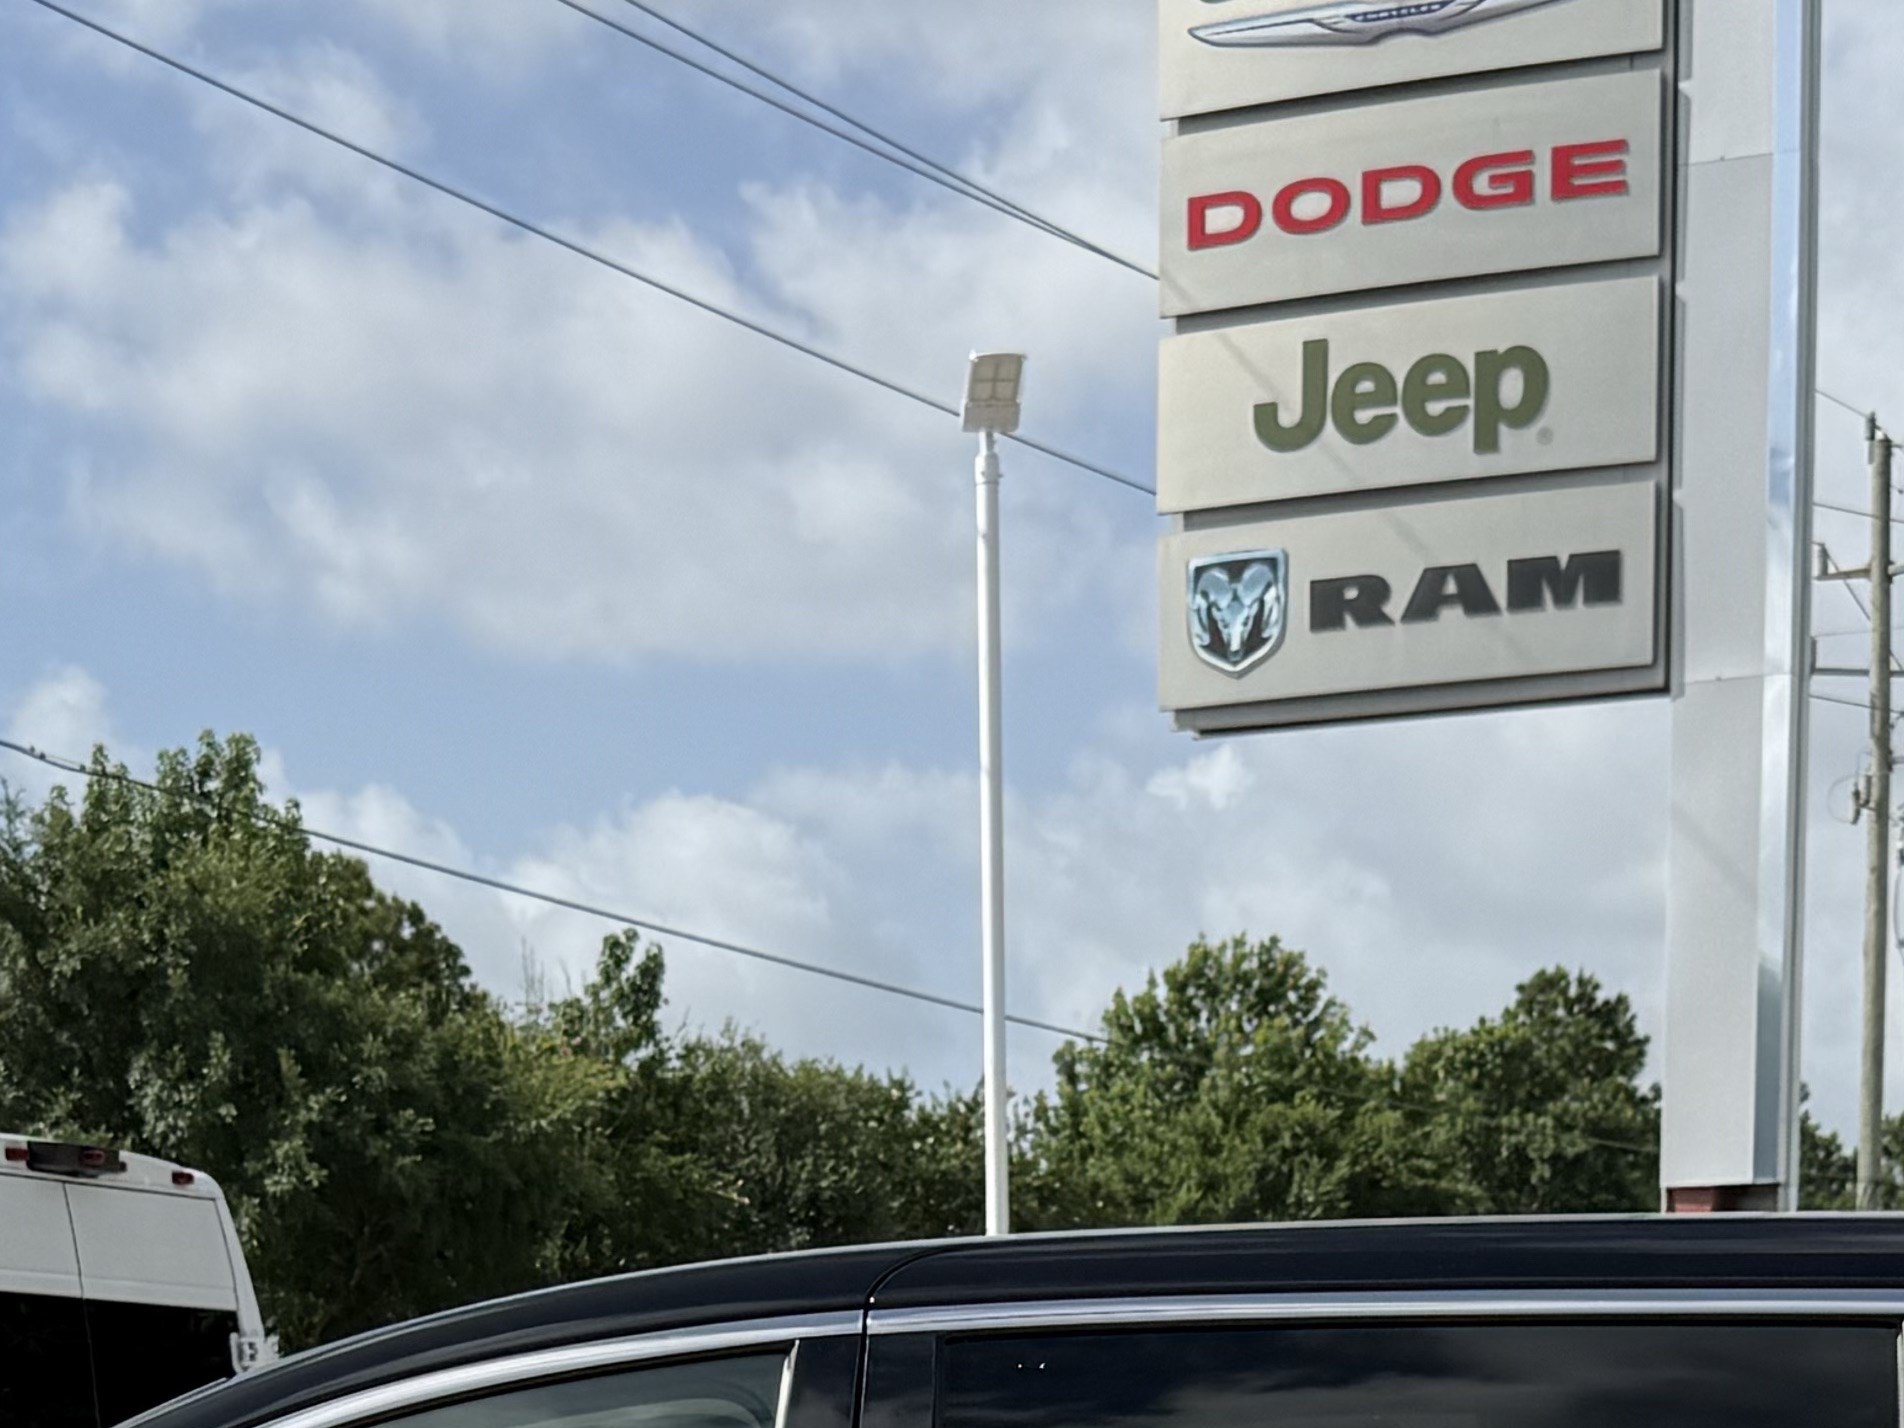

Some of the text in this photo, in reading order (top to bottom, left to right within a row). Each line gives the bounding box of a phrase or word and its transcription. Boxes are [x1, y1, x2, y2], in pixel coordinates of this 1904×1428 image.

[1186, 138, 1630, 252] DODGE
[1253, 338, 1550, 456] Jeep
[1309, 549, 1623, 633] RAM
